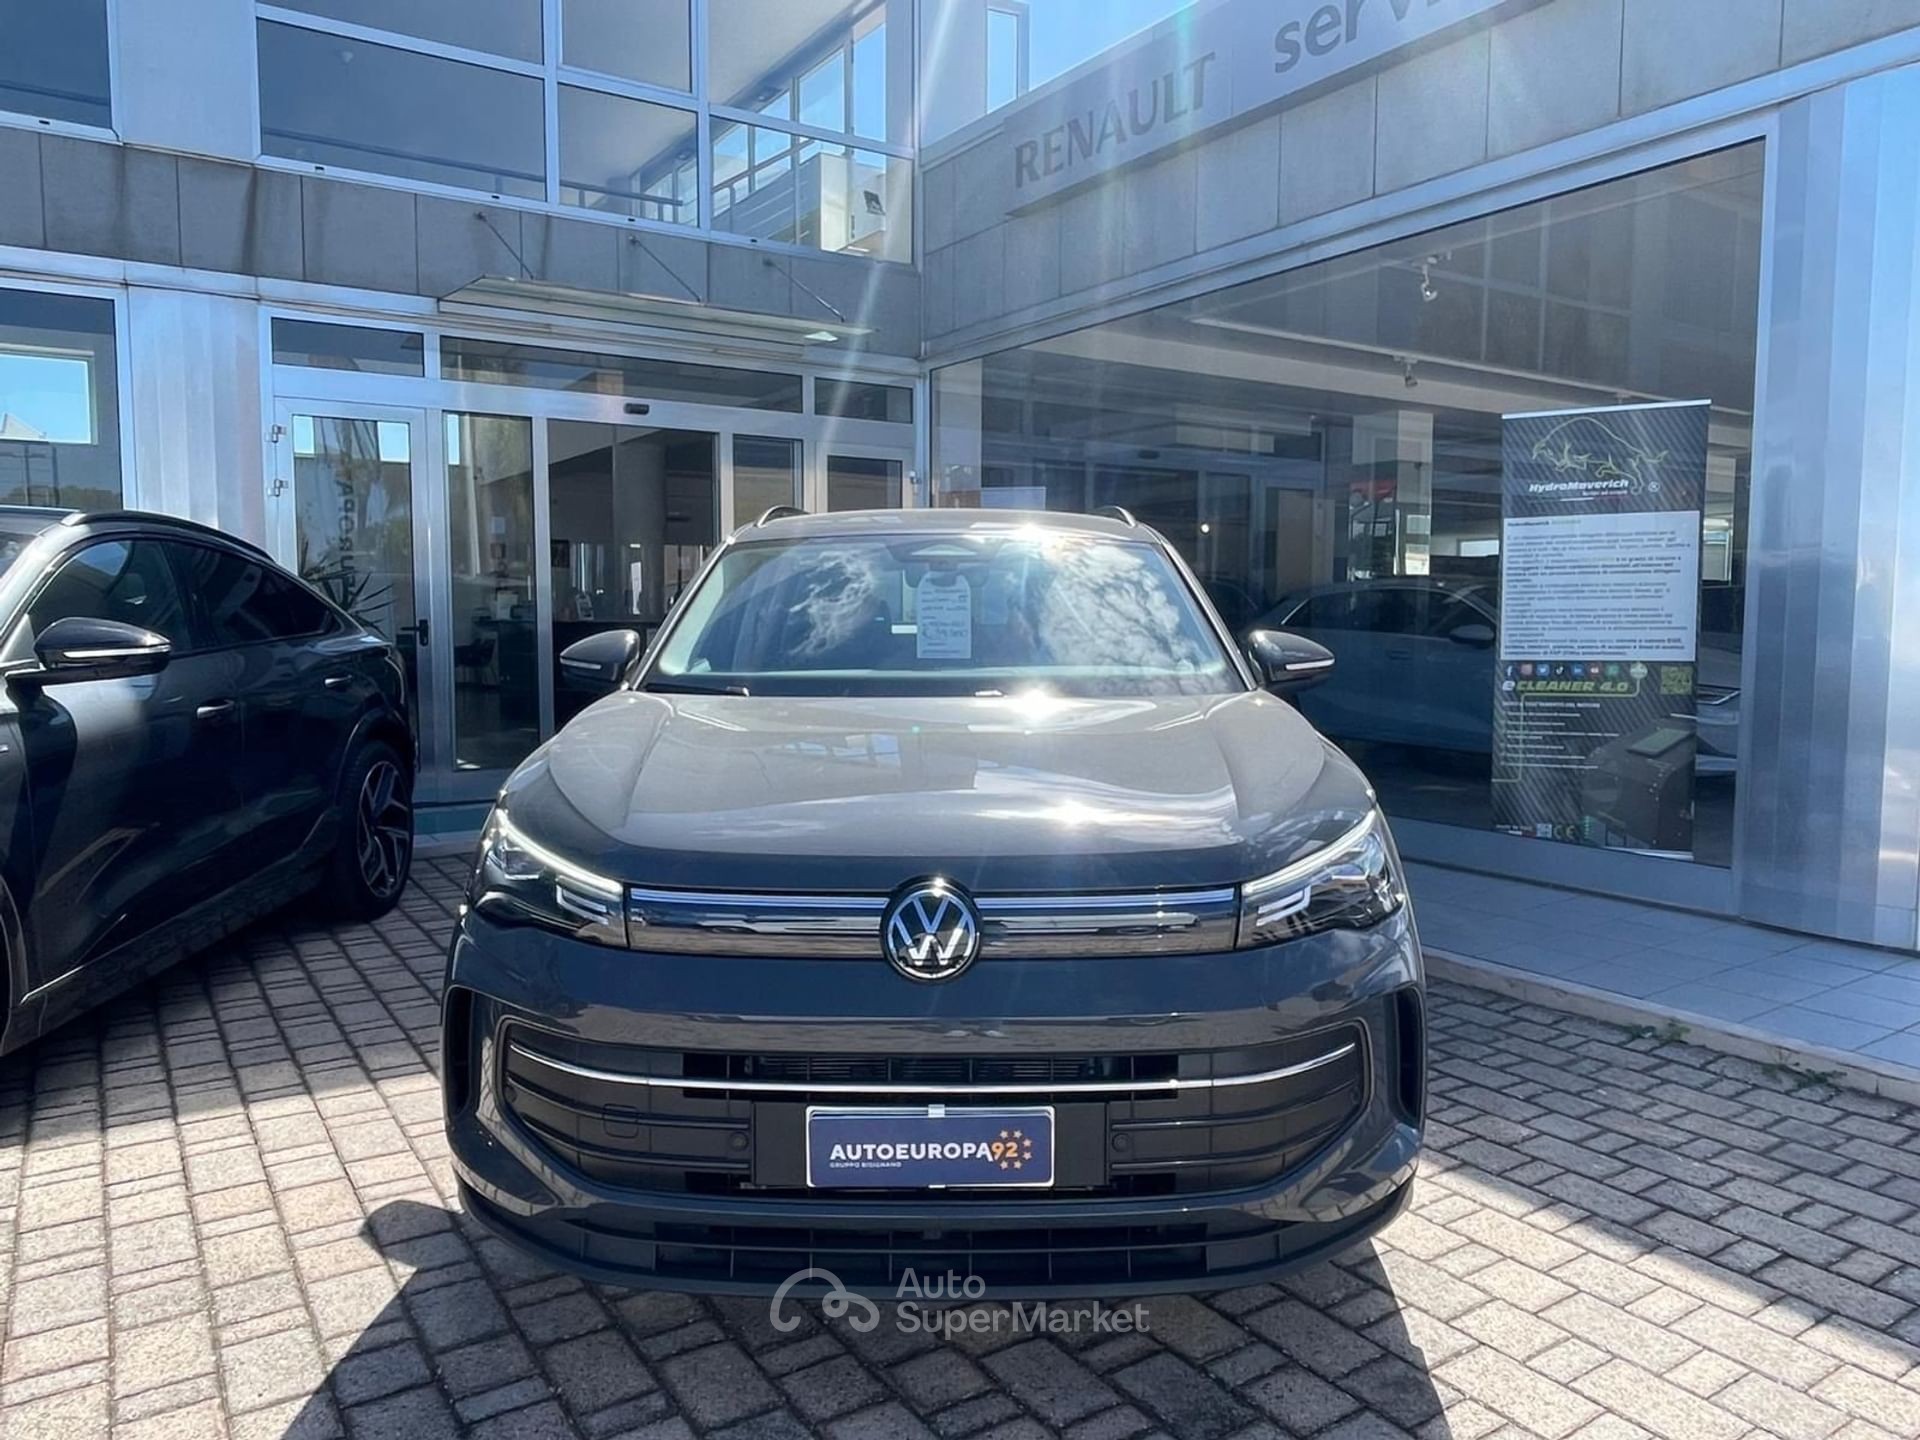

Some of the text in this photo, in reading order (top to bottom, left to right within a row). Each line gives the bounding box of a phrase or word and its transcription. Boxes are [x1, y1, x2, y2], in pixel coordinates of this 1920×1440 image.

[1274, 0, 1441, 73] ser
[1014, 51, 1215, 189] RENAULT
[1599, 681, 1630, 692] 4.0
[829, 1161, 860, 1169] GRUPPO
